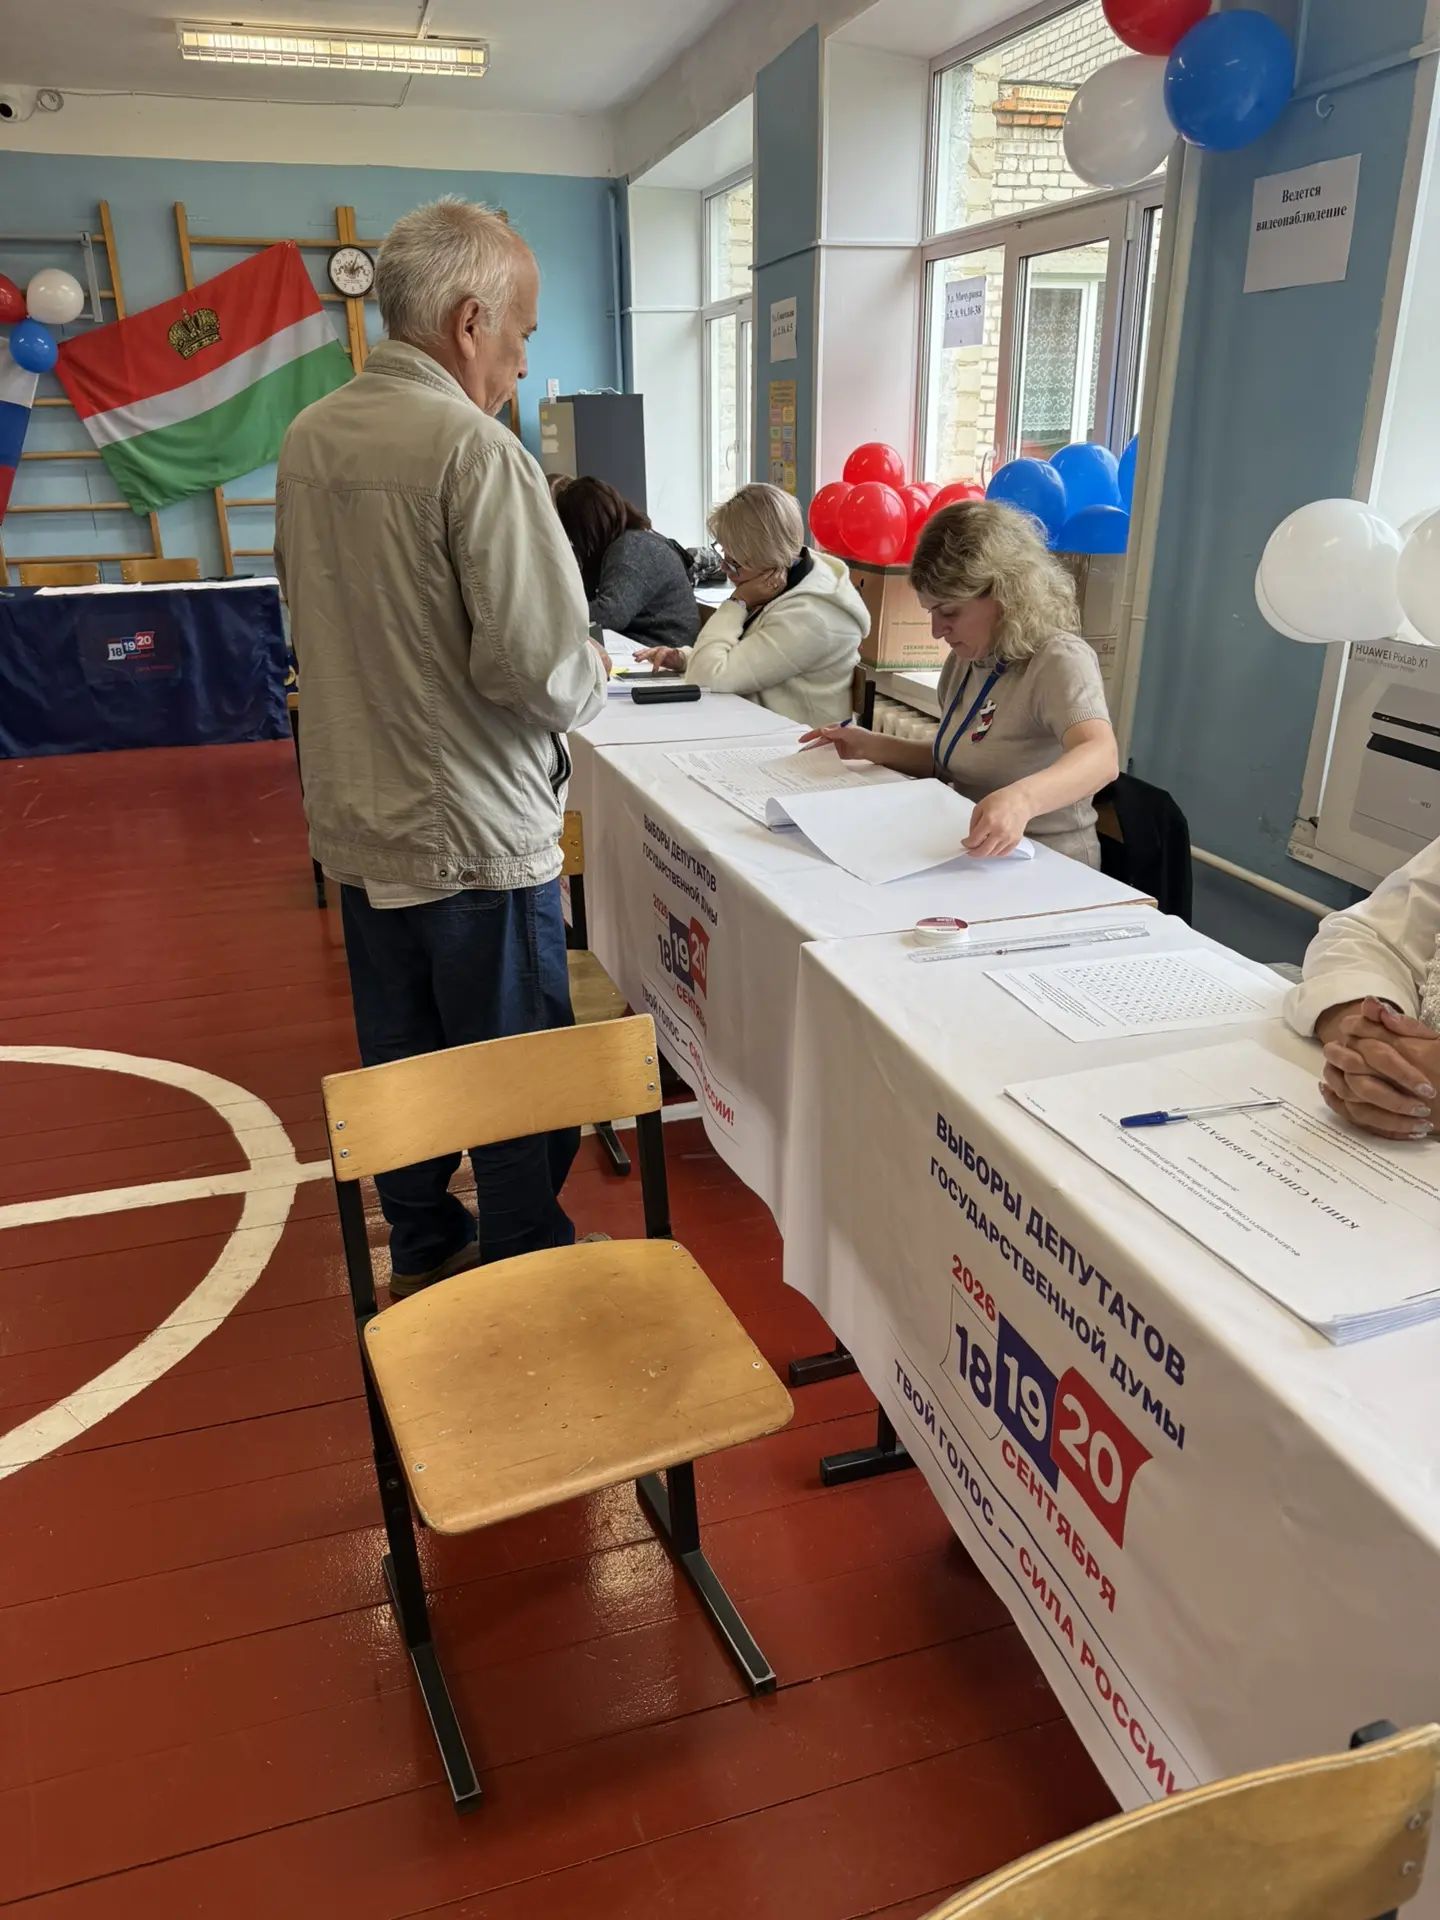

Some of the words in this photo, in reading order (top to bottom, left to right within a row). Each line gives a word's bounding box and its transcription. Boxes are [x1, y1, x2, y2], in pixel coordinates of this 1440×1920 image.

[1255, 204, 1347, 231] видеонаблюдение
[1281, 185, 1321, 203] Ведется
[110, 647, 122, 657] 18
[124, 641, 136, 651] 19
[137, 635, 152, 646] 20
[1356, 644, 1392, 660] HUAWEI
[1393, 652, 1417, 666] PixLab
[1418, 657, 1428, 669] X1
[642, 842, 701, 905] ГОСУДАРСТВЕННОЙ
[643, 813, 671, 852] ВЫБОРЫ
[671, 841, 717, 893] ДЕПУТАТОВ
[657, 933, 672, 975] 18
[672, 931, 691, 974] 19
[690, 932, 706, 980] 20
[1256, 1160, 1309, 1197] СПИСКА
[1312, 1197, 1360, 1229] КНИГА
[936, 1111, 1022, 1219] ВЫБОРЫ
[1025, 1206, 1186, 1387] ДЕПУТАТОВ
[931, 1156, 1105, 1363] ГОСУДАРСТВЕННОЙ
[1110, 1353, 1185, 1450] ДУМЫ
[952, 1254, 996, 1322] 2026
[955, 1322, 992, 1409] 18
[1003, 1353, 1047, 1442] 19
[1058, 1393, 1124, 1504] 20
[894, 1359, 936, 1436] ТВОЙ
[939, 1430, 994, 1526] ГОЛОС
[1019, 1546, 1075, 1648] СИЛА
[1001, 1439, 1117, 1613] СЕНТЯБРЯ
